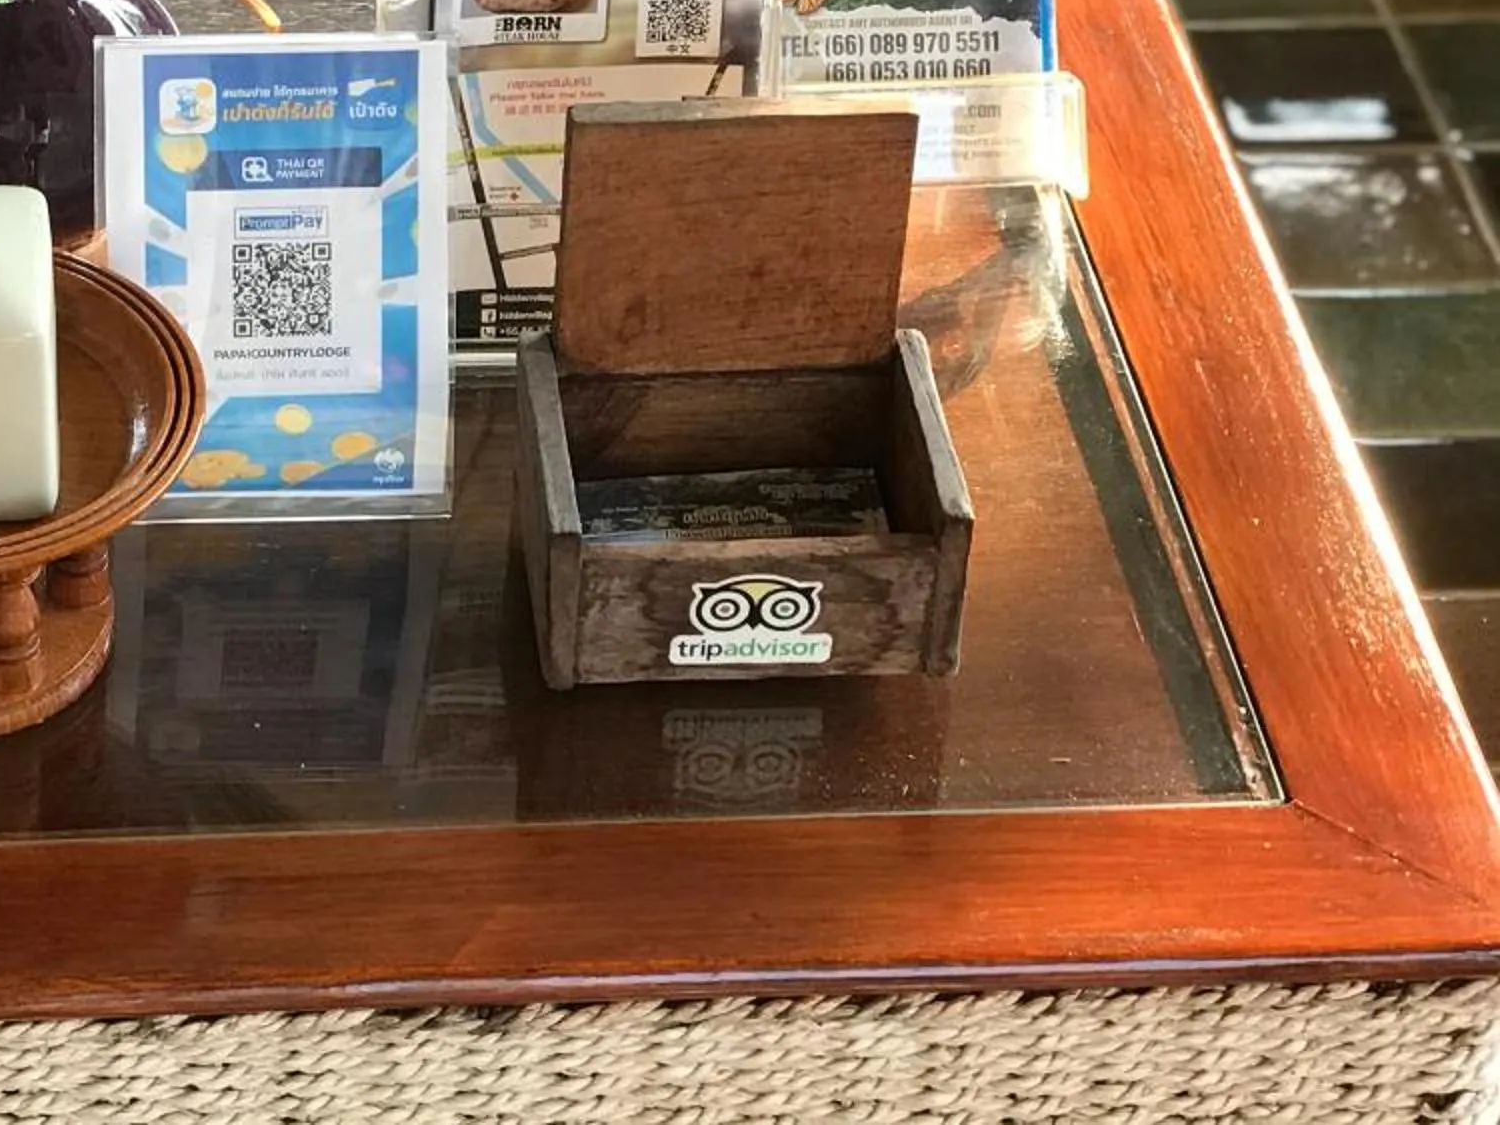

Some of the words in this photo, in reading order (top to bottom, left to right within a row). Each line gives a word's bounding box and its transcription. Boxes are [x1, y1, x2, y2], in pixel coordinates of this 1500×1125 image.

[825, 34, 864, 56] (66)
[870, 32, 907, 54] 089
[913, 31, 949, 54] 970
[956, 30, 999, 53] 5511
[825, 62, 864, 83] (66)
[870, 60, 908, 81] 053
[913, 59, 947, 80] 010
[953, 58, 991, 77] 660
[350, 100, 397, 118] เป๋าตัง
[276, 158, 305, 168] THAI
[308, 158, 325, 168] QR
[276, 170, 325, 179] PAYMENT
[240, 213, 323, 231] PromptPay
[213, 346, 352, 360] PAPAICOUNTRYLODGE
[678, 639, 820, 661] tripadvisor
